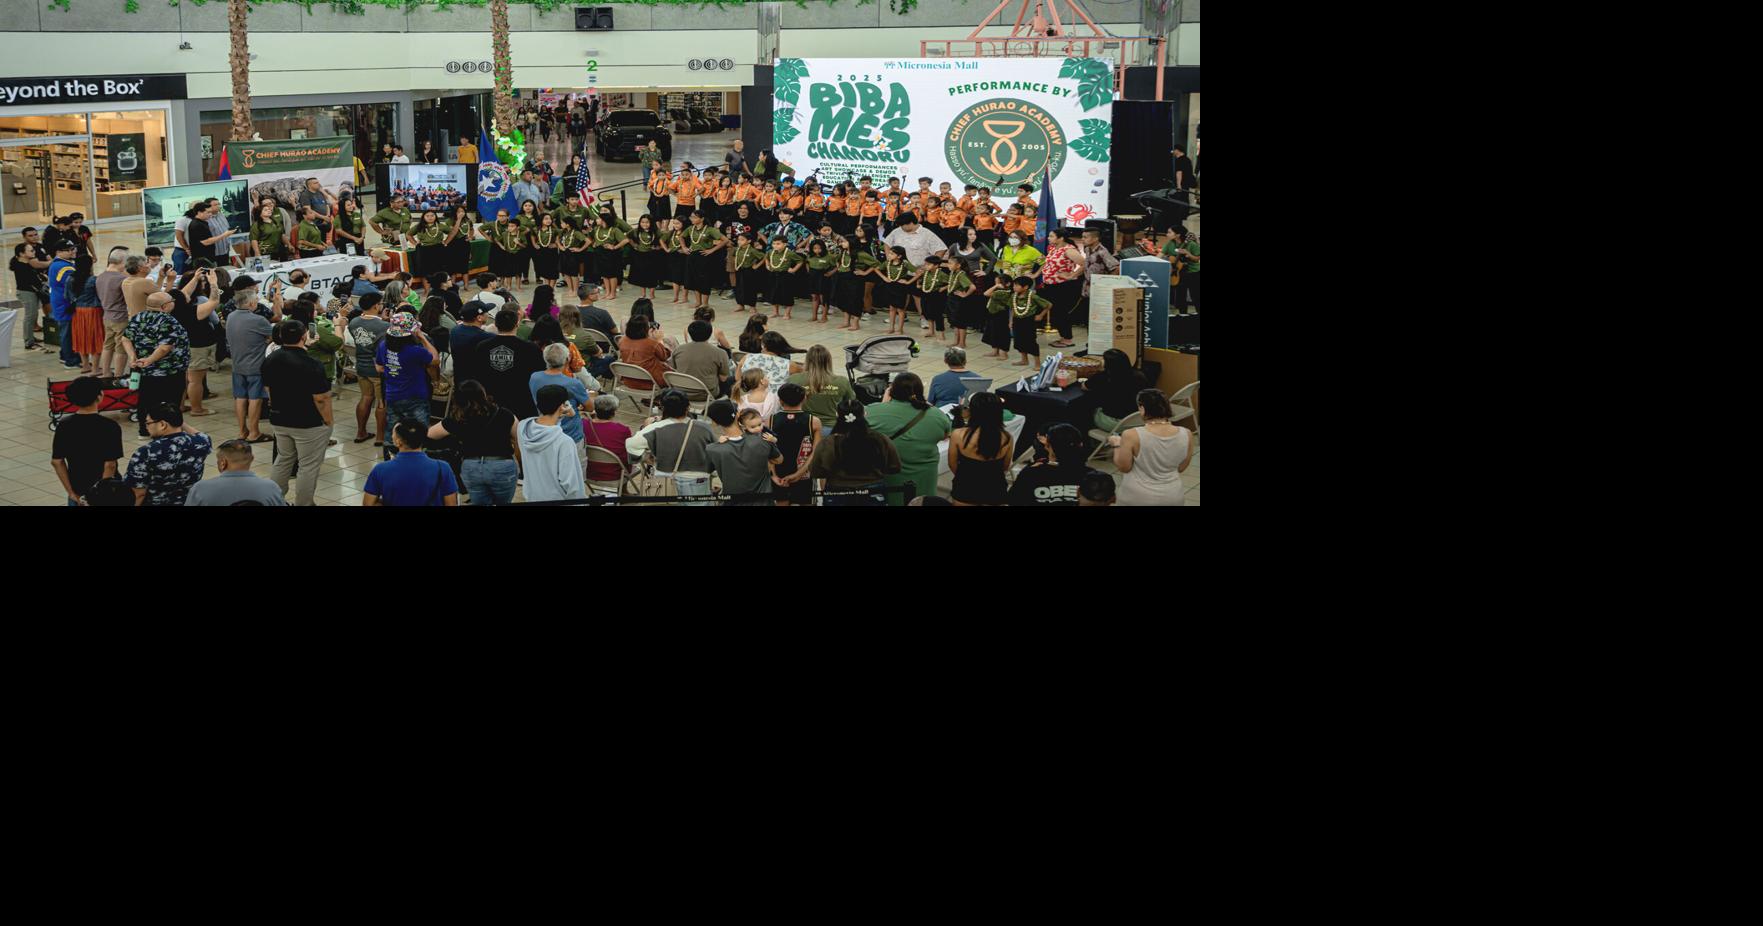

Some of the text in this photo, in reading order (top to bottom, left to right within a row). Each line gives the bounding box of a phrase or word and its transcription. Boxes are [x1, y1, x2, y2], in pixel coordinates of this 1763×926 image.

[586, 60, 598, 71] 2
[897, 61, 978, 70] Micronesia Mall
[64, 80, 98, 96] the
[948, 81, 1071, 97] PERFORMANCE BY
[809, 82, 911, 119] BIBA
[808, 106, 910, 150] MES
[950, 102, 1062, 145] CHIEF HURAO ACADEMY
[807, 142, 910, 163] CHAMORU
[1144, 292, 1152, 323] Junior
[1034, 484, 1080, 498] OBE
